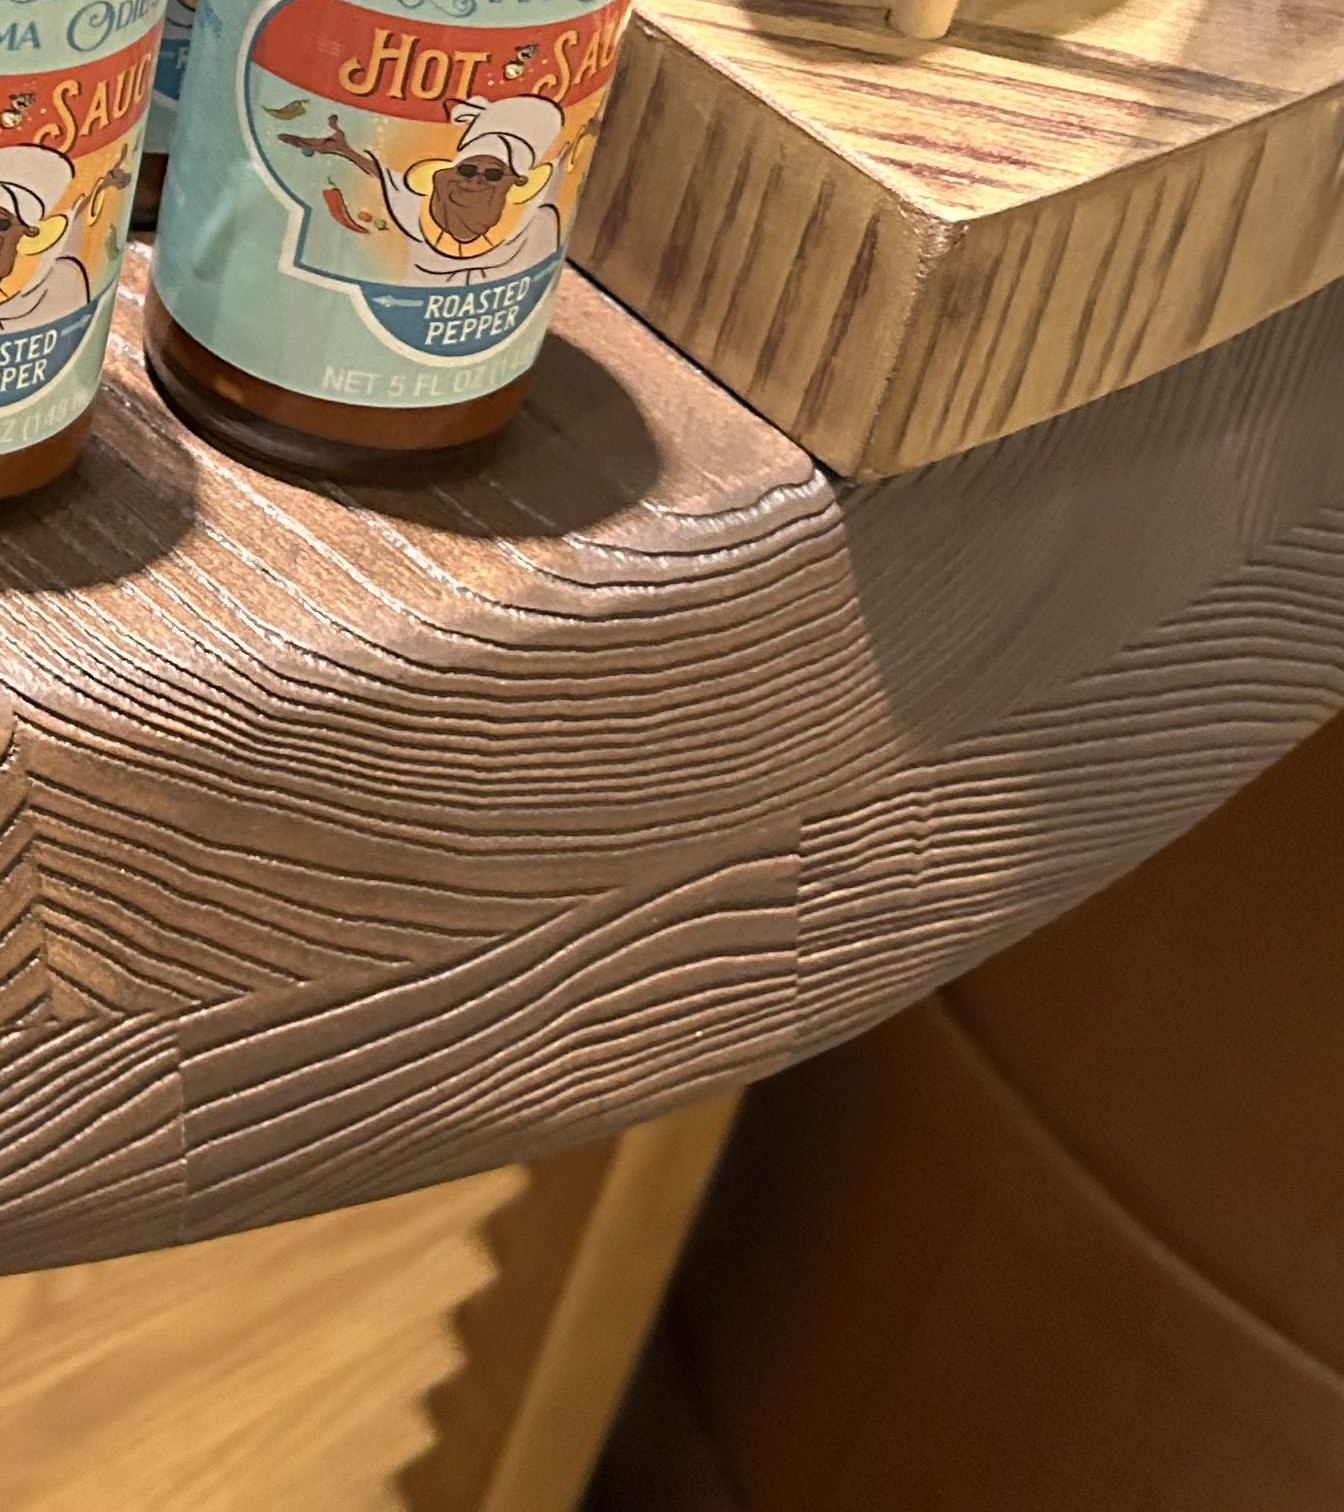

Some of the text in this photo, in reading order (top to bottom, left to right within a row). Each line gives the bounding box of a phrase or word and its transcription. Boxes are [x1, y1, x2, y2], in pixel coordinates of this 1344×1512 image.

[338, 9, 622, 104] HOT SAU
[32, 47, 154, 155] SAUC
[424, 276, 531, 320] ROASTED
[424, 306, 519, 346] PEPPER
[321, 365, 382, 396] NET
[389, 374, 407, 398] 5
[412, 373, 444, 397] FL
[452, 365, 483, 395] OZ
